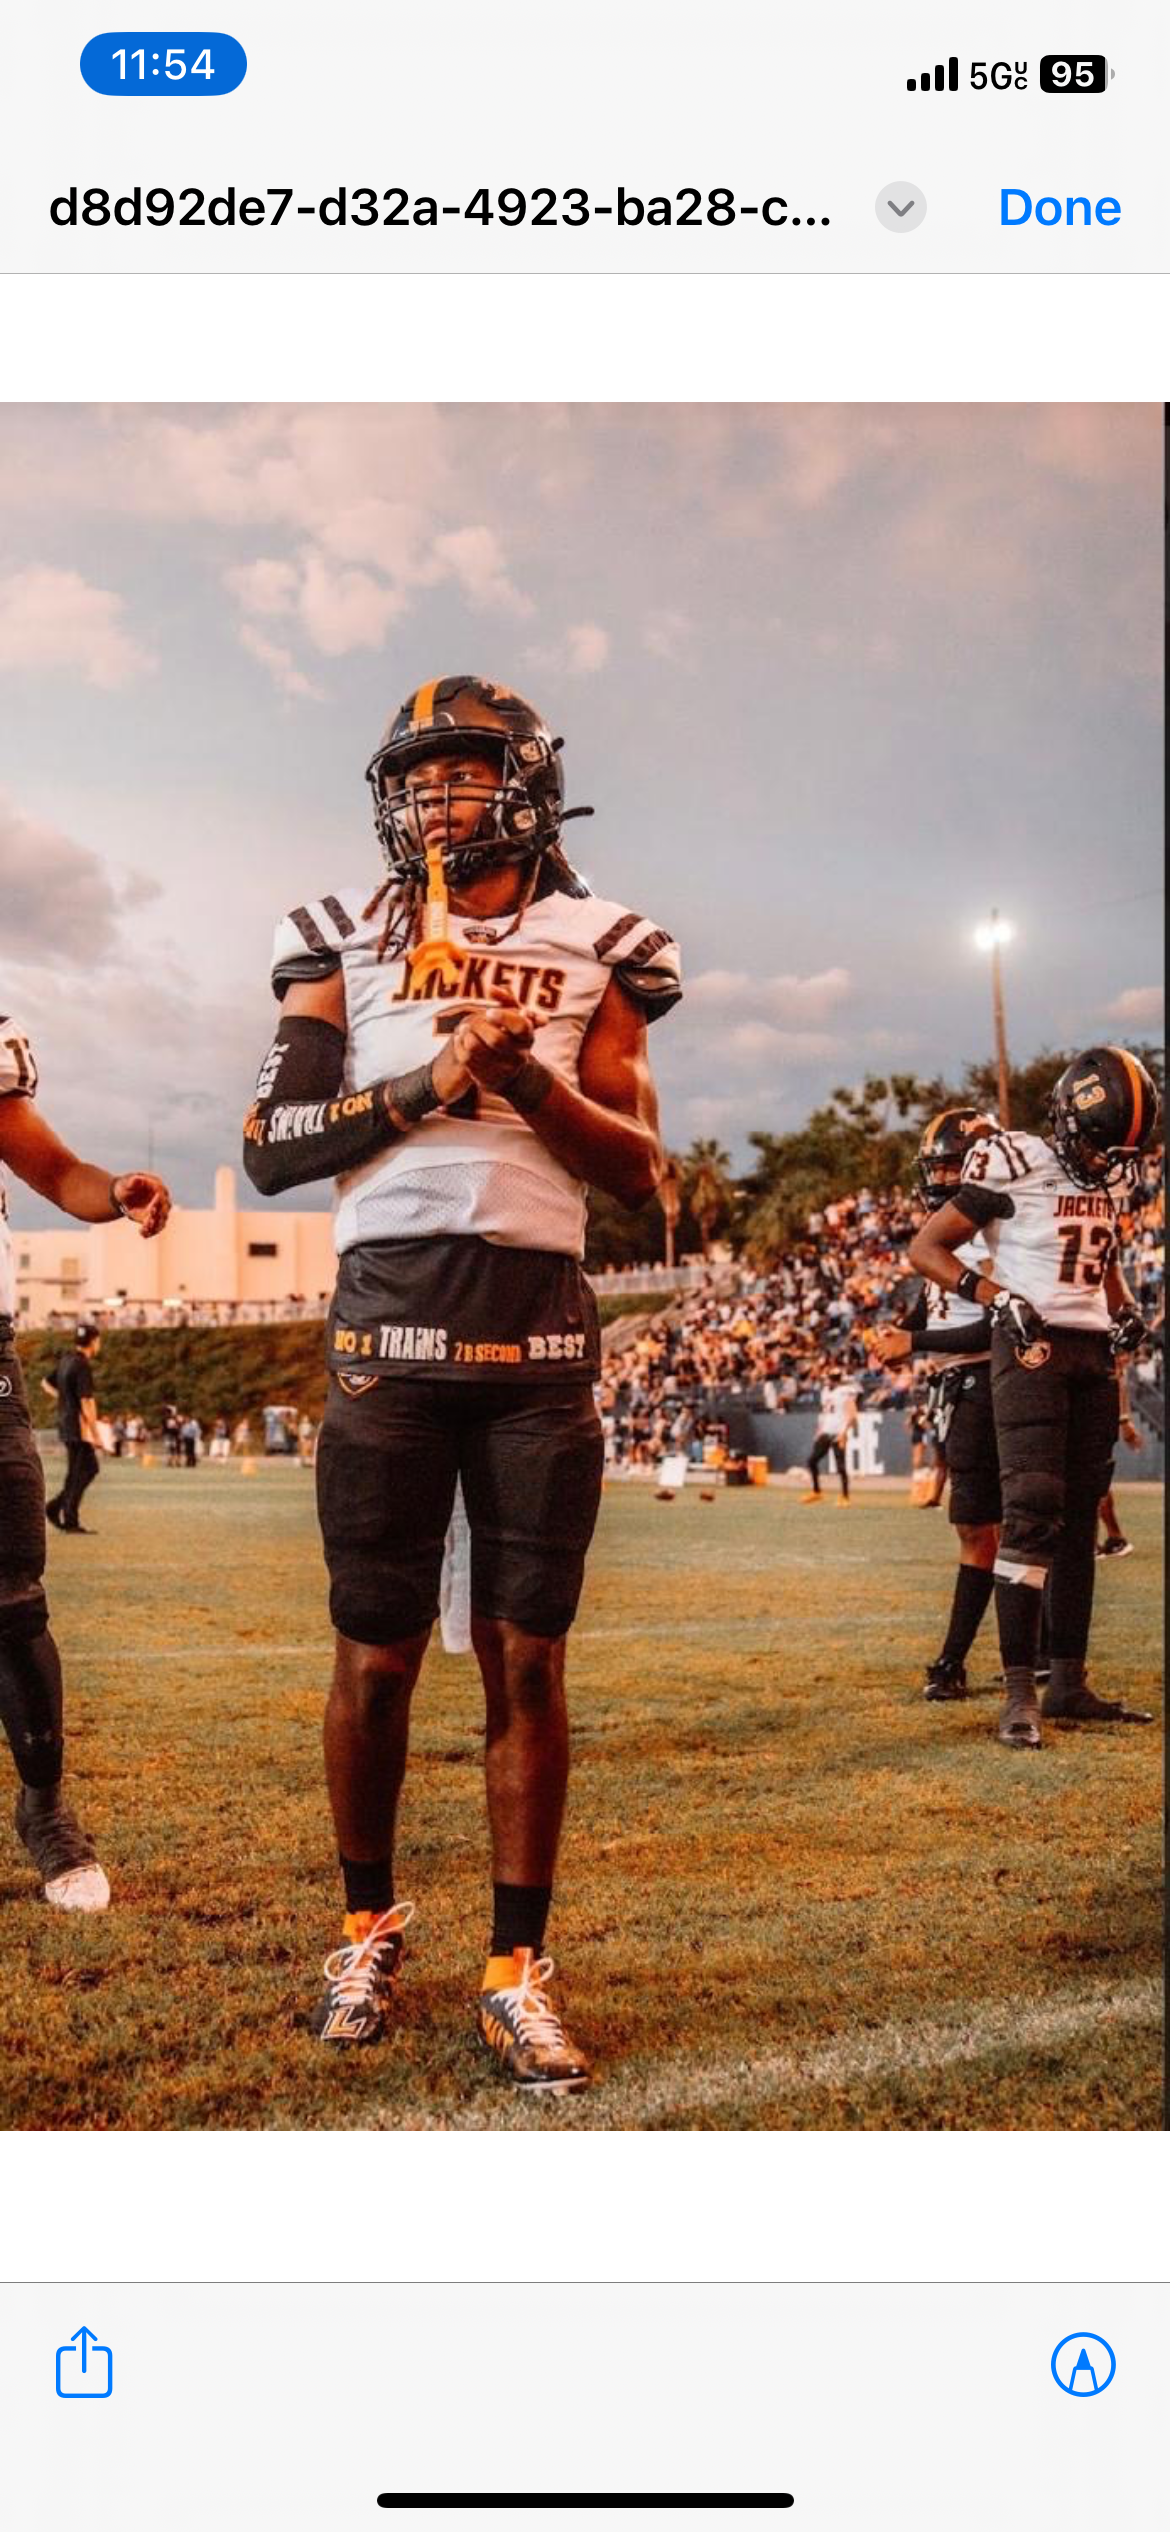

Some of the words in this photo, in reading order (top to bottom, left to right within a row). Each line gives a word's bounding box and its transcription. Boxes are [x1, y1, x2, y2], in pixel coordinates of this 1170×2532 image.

[342, 1091, 374, 1116] NO
[1072, 1073, 1107, 1111] 13
[329, 1103, 340, 1122] 1
[1057, 1224, 1113, 1286] 13
[334, 1330, 357, 1353] NO
[361, 1333, 372, 1356] 1
[454, 1342, 463, 1361] 2
[475, 1343, 521, 1363] SECOND
[528, 1333, 586, 1360] BEST
[321, 2005, 367, 2040] L
